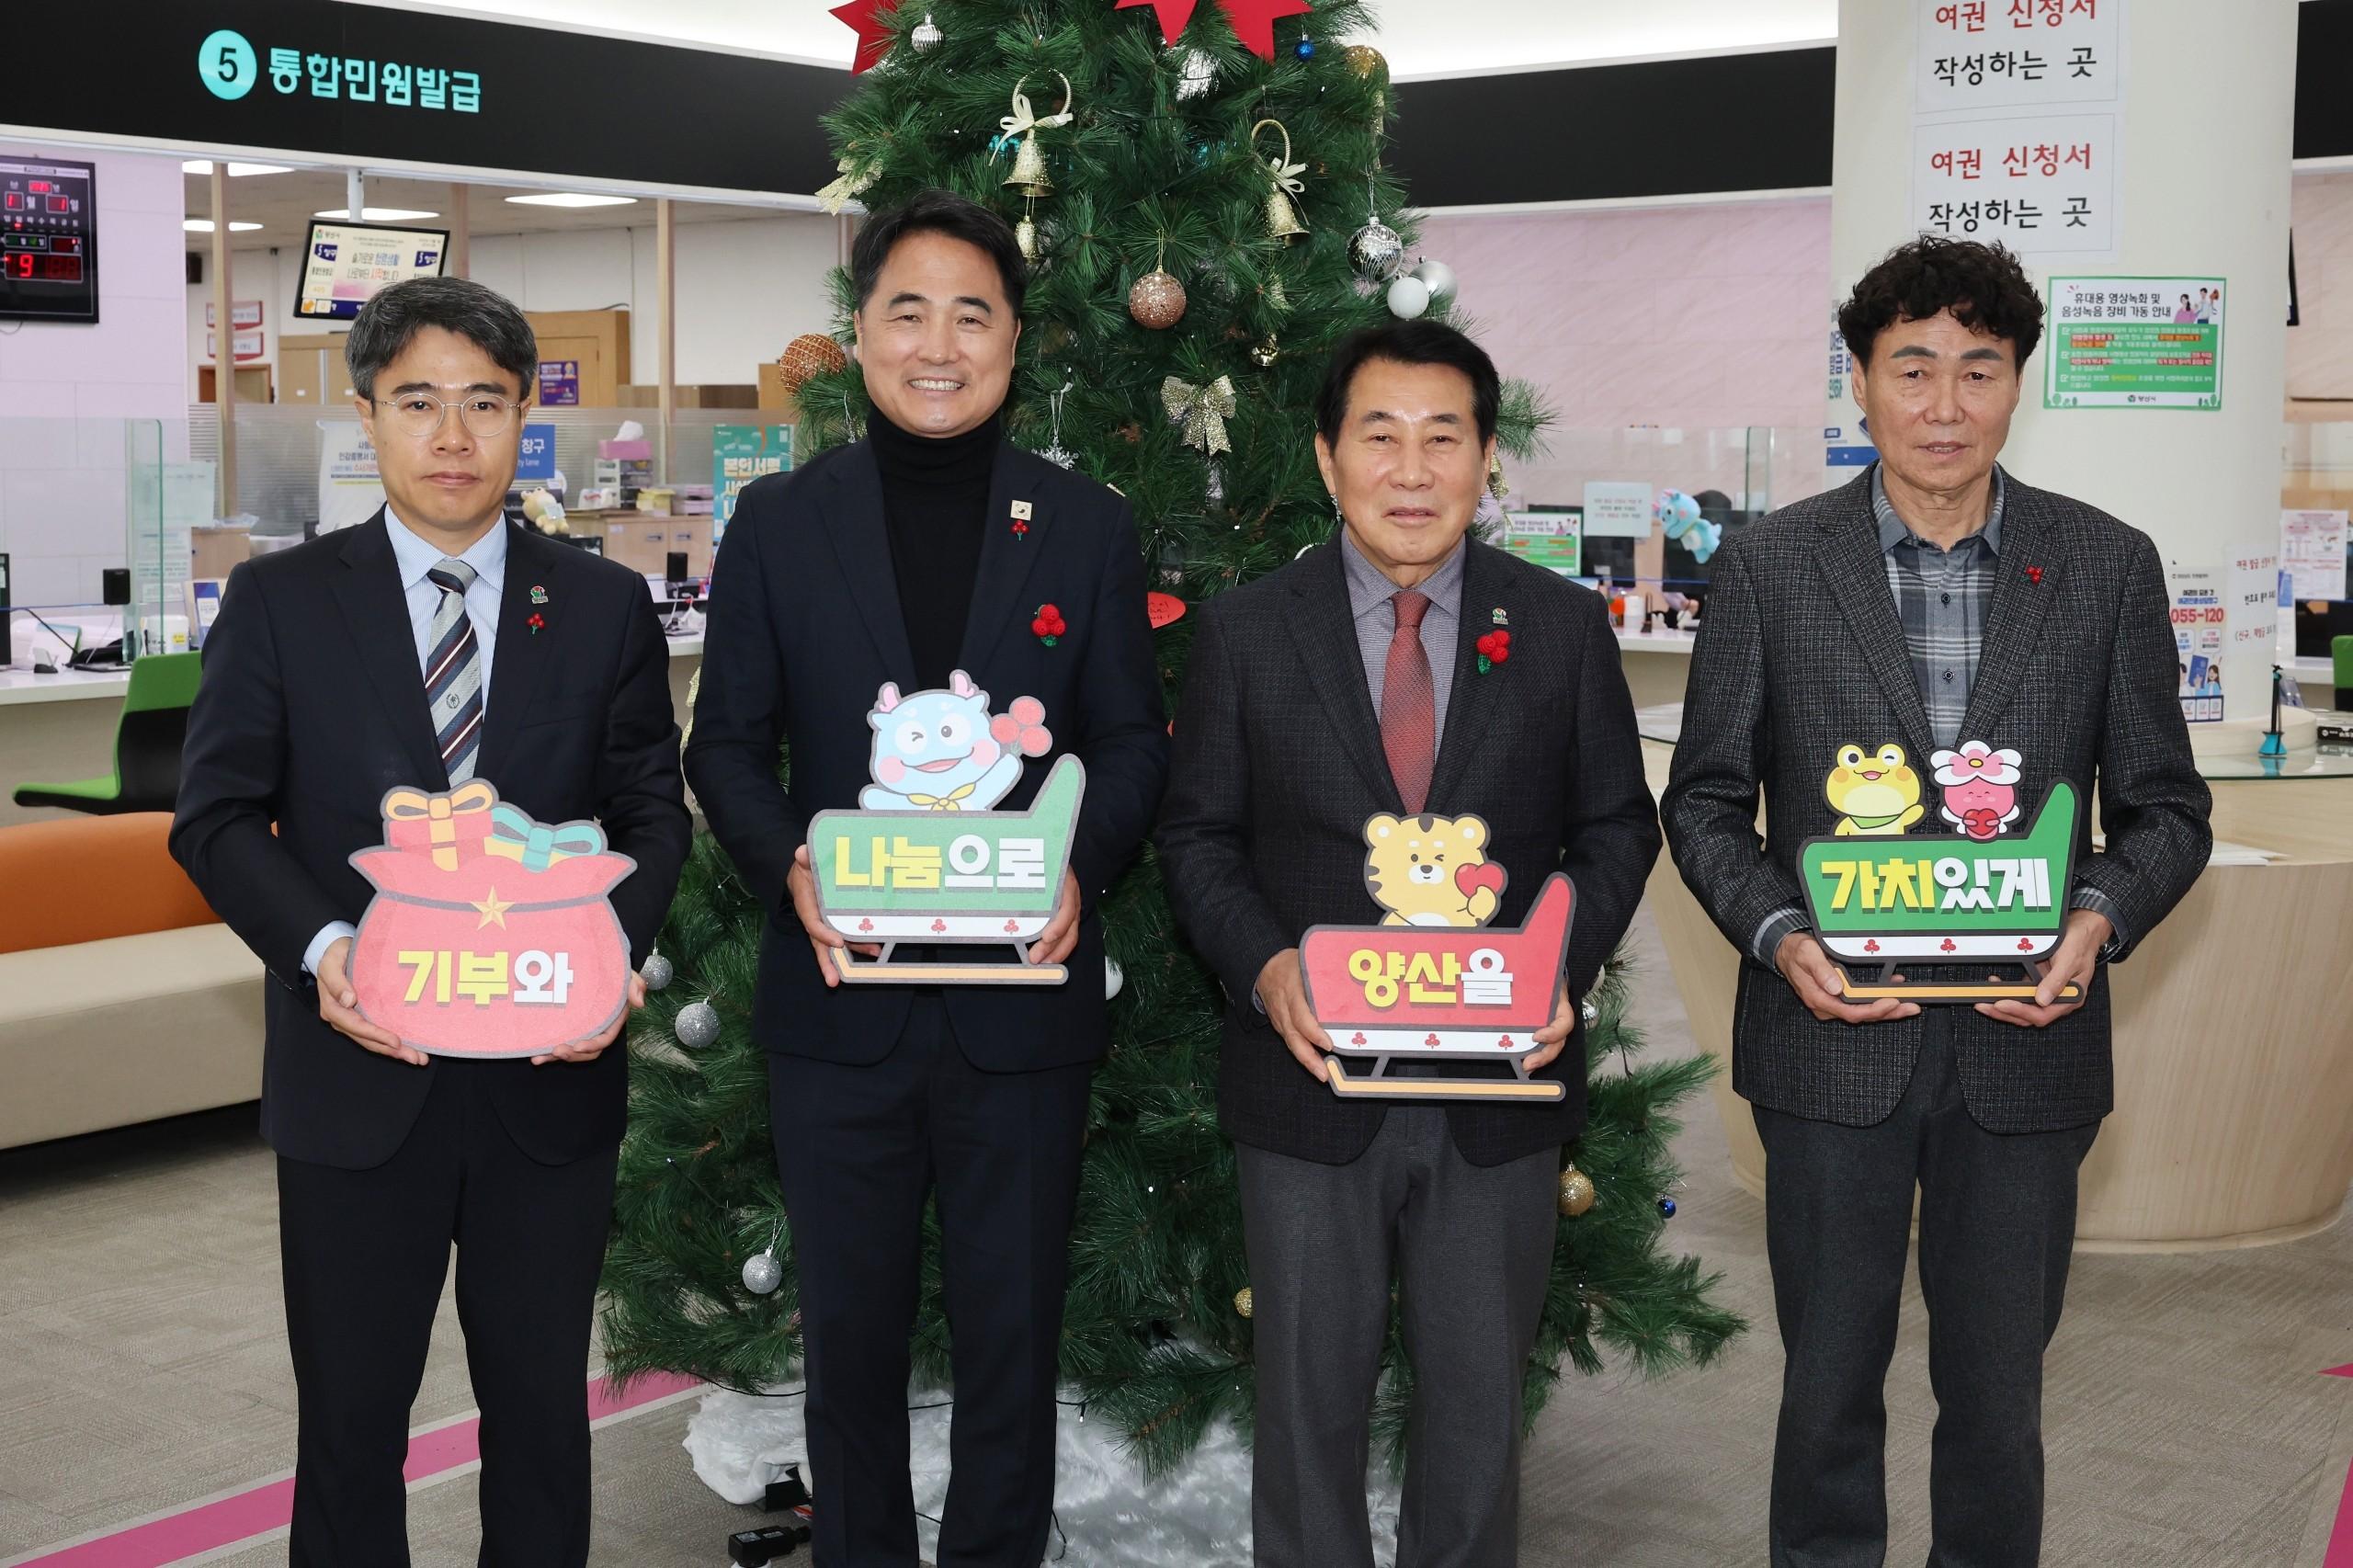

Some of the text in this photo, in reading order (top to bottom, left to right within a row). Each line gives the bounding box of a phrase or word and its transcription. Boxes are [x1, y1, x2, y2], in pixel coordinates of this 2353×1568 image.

[1936, 0, 2096, 32] 여권 신청서
[218, 46, 481, 113] 5 통합민원발급
[1934, 47, 2097, 86] 작성하는 곳
[1931, 143, 2091, 179] 여권 신청서
[1929, 197, 2092, 233] 작성하는 곳
[2062, 305, 2171, 318] 음성녹음 장비 가동 안내
[2075, 292, 2161, 304] 휴대용 영상녹화 및
[521, 437, 545, 454] 창구
[2170, 608, 2224, 623] 055-120
[835, 835, 1046, 889] 나눔으로
[1821, 857, 2052, 910] 가치있게
[397, 949, 574, 1005] 기부와
[1348, 948, 1514, 1008] 양산을
